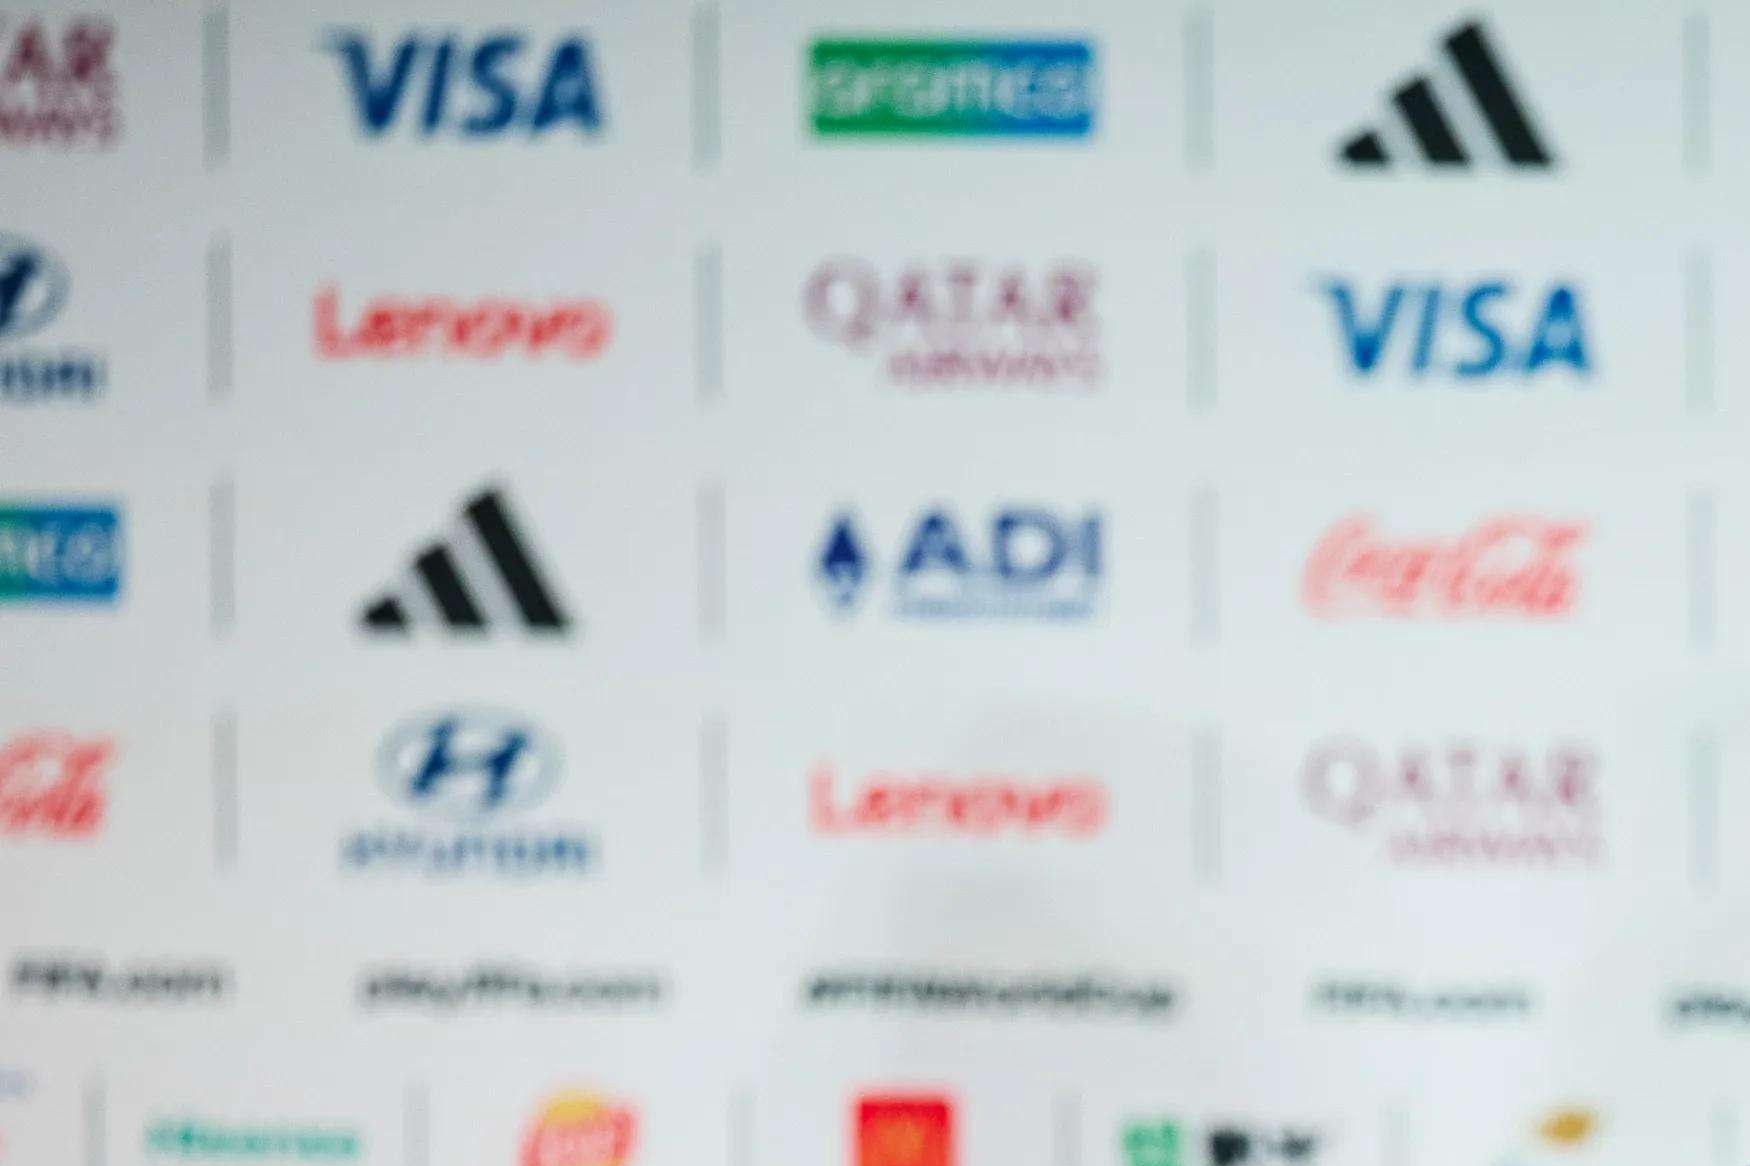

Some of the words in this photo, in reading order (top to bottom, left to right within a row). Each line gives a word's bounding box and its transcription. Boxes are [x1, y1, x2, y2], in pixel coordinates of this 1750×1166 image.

[328, 33, 604, 137] VISA
[813, 58, 1088, 120] aramco
[313, 290, 610, 359] Lenovo
[806, 260, 1094, 346] QATAR
[1320, 278, 1593, 378] VISA
[898, 506, 1103, 580] ADI
[812, 774, 1106, 833] Lenovo
[1303, 738, 1597, 825] QATAR
